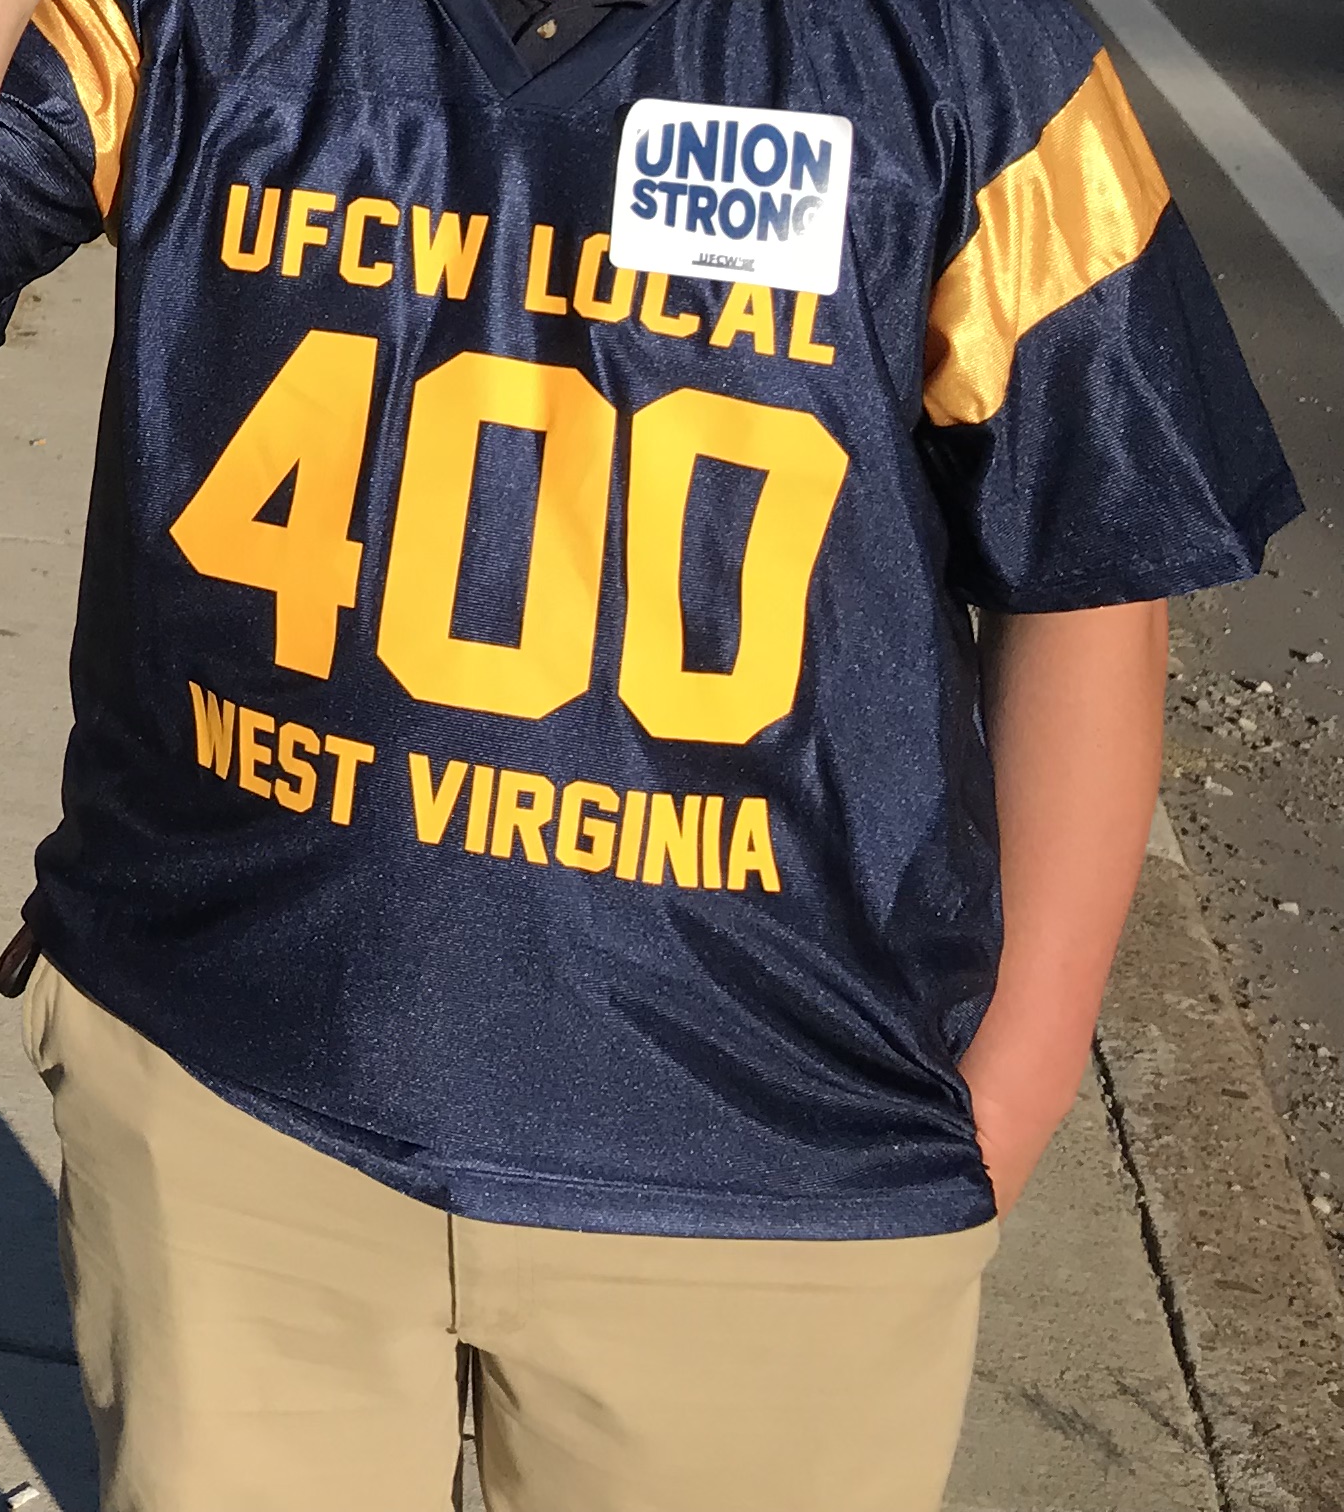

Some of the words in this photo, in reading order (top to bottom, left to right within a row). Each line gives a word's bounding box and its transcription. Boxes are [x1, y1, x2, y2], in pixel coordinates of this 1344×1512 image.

[630, 177, 827, 243] STRONG
[636, 120, 833, 194] UNION
[220, 183, 491, 302] UFCW
[168, 329, 851, 746] 400
[187, 679, 376, 826] WEST
[408, 752, 782, 894] VIRGINIA
